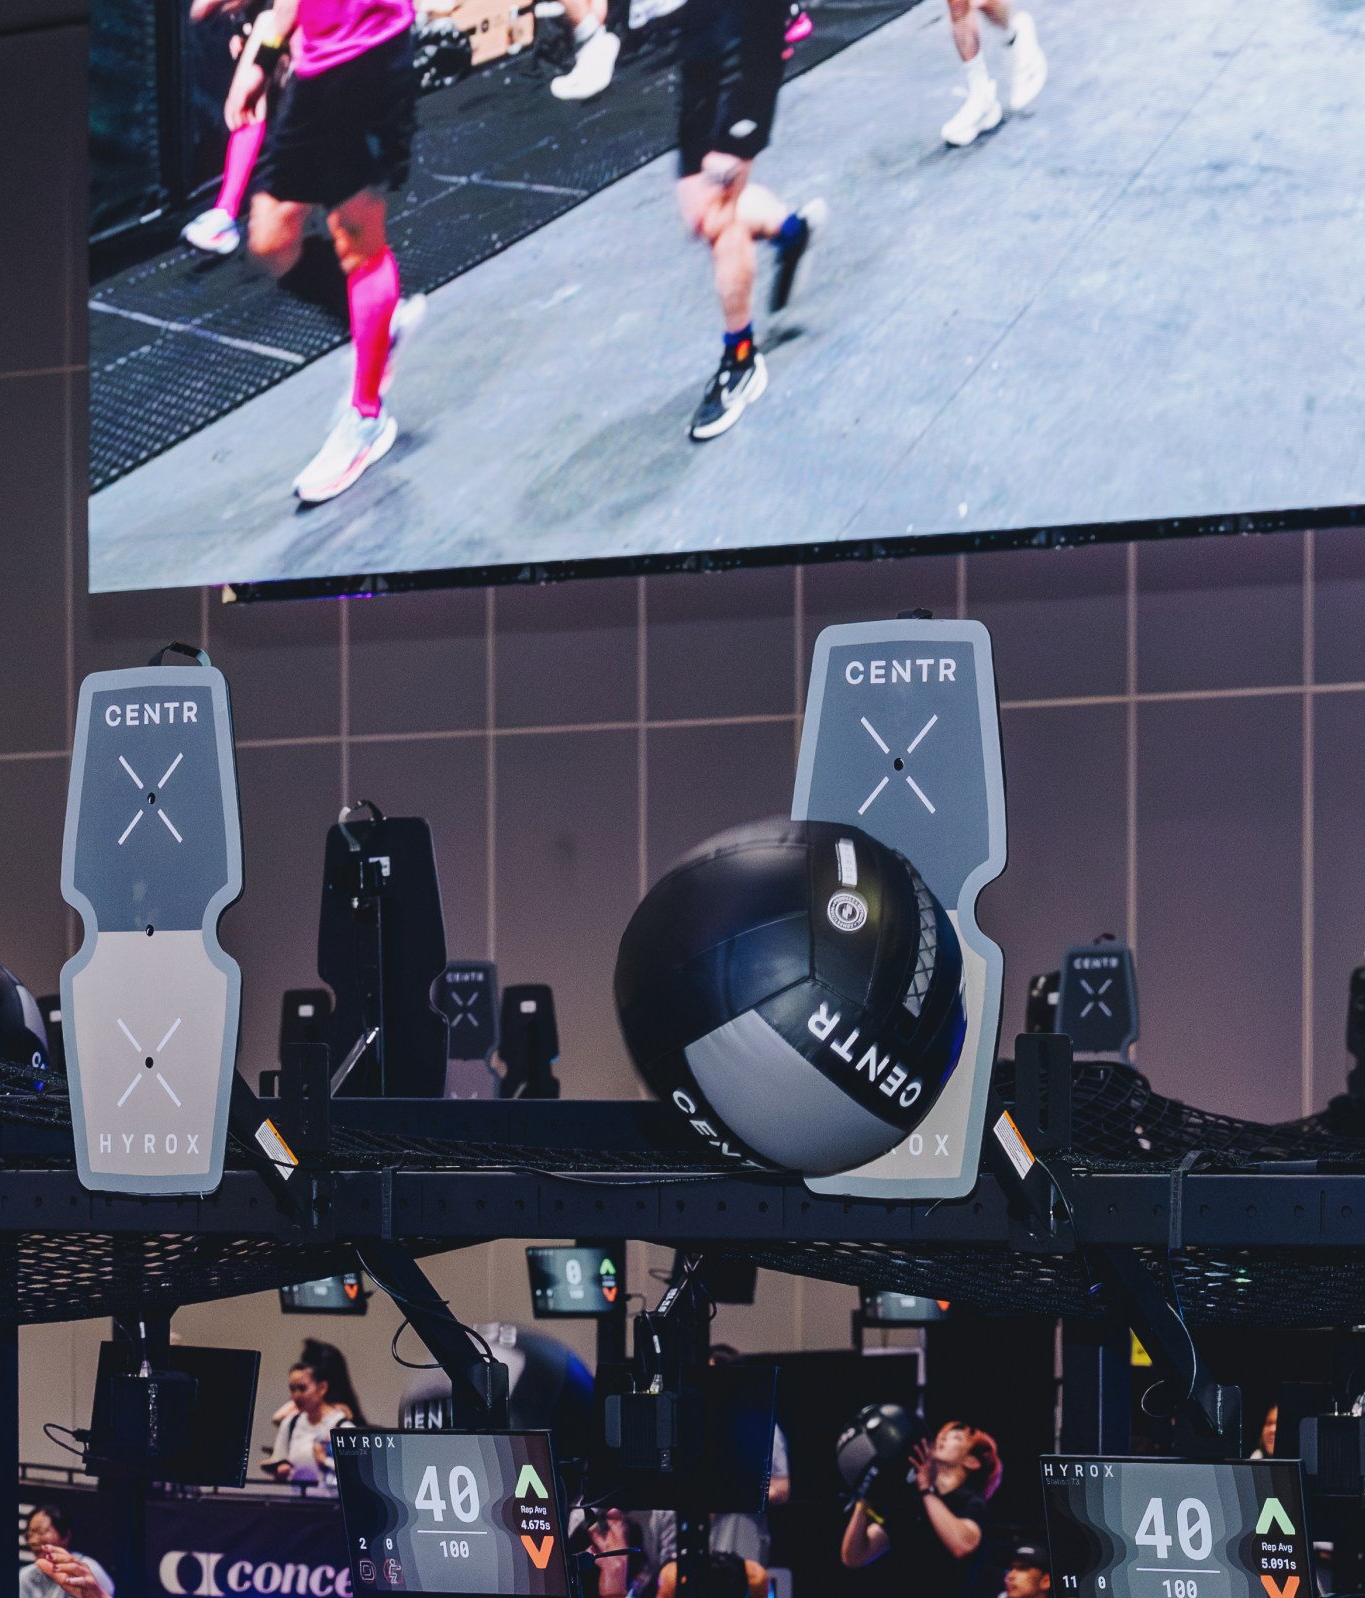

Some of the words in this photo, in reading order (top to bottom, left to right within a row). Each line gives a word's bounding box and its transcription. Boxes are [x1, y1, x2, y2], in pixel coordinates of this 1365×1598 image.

[845, 658, 957, 685] CENTR
[105, 701, 197, 727] CENTR
[807, 1001, 923, 1108] CENTR
[100, 1134, 199, 1154] HYROX
[337, 1437, 395, 1448] HYROX
[1045, 1465, 1114, 1479] HYROX
[415, 1465, 480, 1523] 40
[520, 1505, 533, 1514] Rep
[534, 1506, 547, 1515] Avg
[521, 1520, 551, 1530] 4.675s
[1135, 1497, 1213, 1561] 40
[359, 1538, 367, 1550] 2
[386, 1538, 393, 1551] 0
[440, 1540, 470, 1558] 100
[1261, 1542, 1276, 1552] Rep
[1278, 1543, 1293, 1554] Avg
[1261, 1558, 1297, 1570] 5.091s
[226, 1562, 353, 1598] conce
[1063, 1575, 1077, 1589] 11
[1098, 1575, 1106, 1590] 0
[1163, 1580, 1198, 1598] 100
